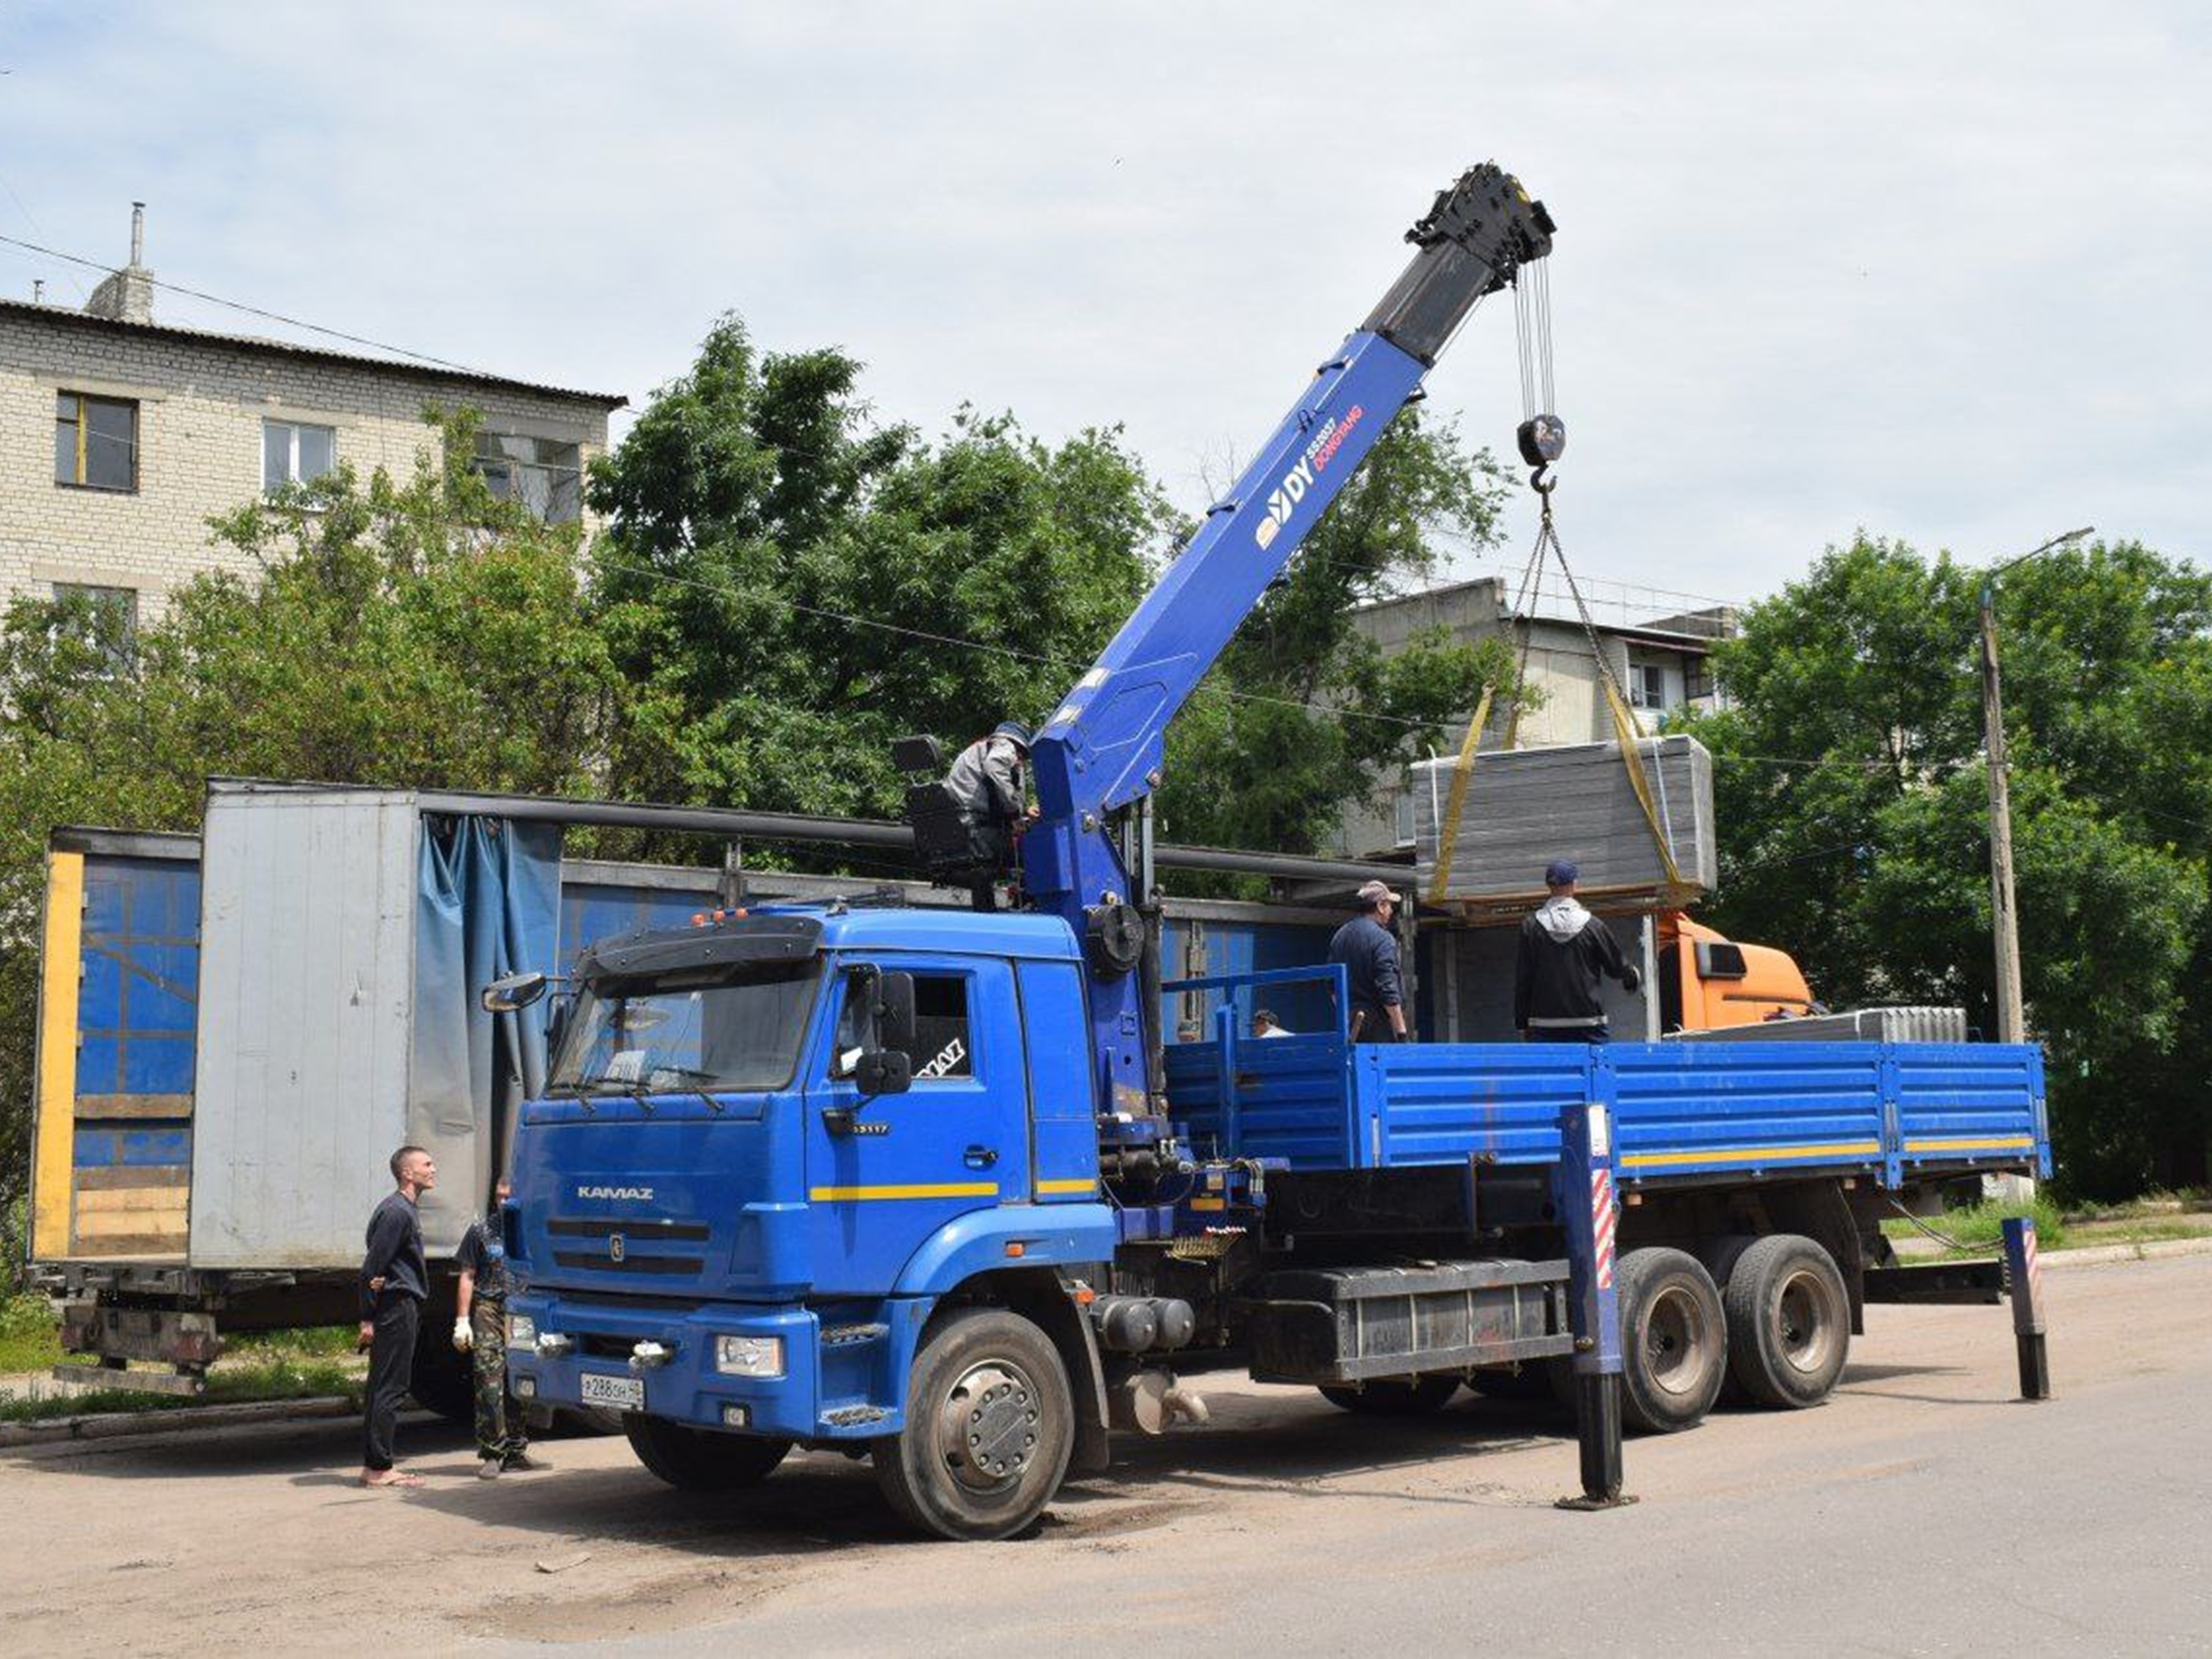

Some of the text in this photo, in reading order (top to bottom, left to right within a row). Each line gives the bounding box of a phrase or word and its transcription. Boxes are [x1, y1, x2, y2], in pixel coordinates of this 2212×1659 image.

[1313, 405, 1364, 473] DONGYANG
[1283, 455, 1314, 504] DY
[578, 1186, 655, 1200] KAMAZ
